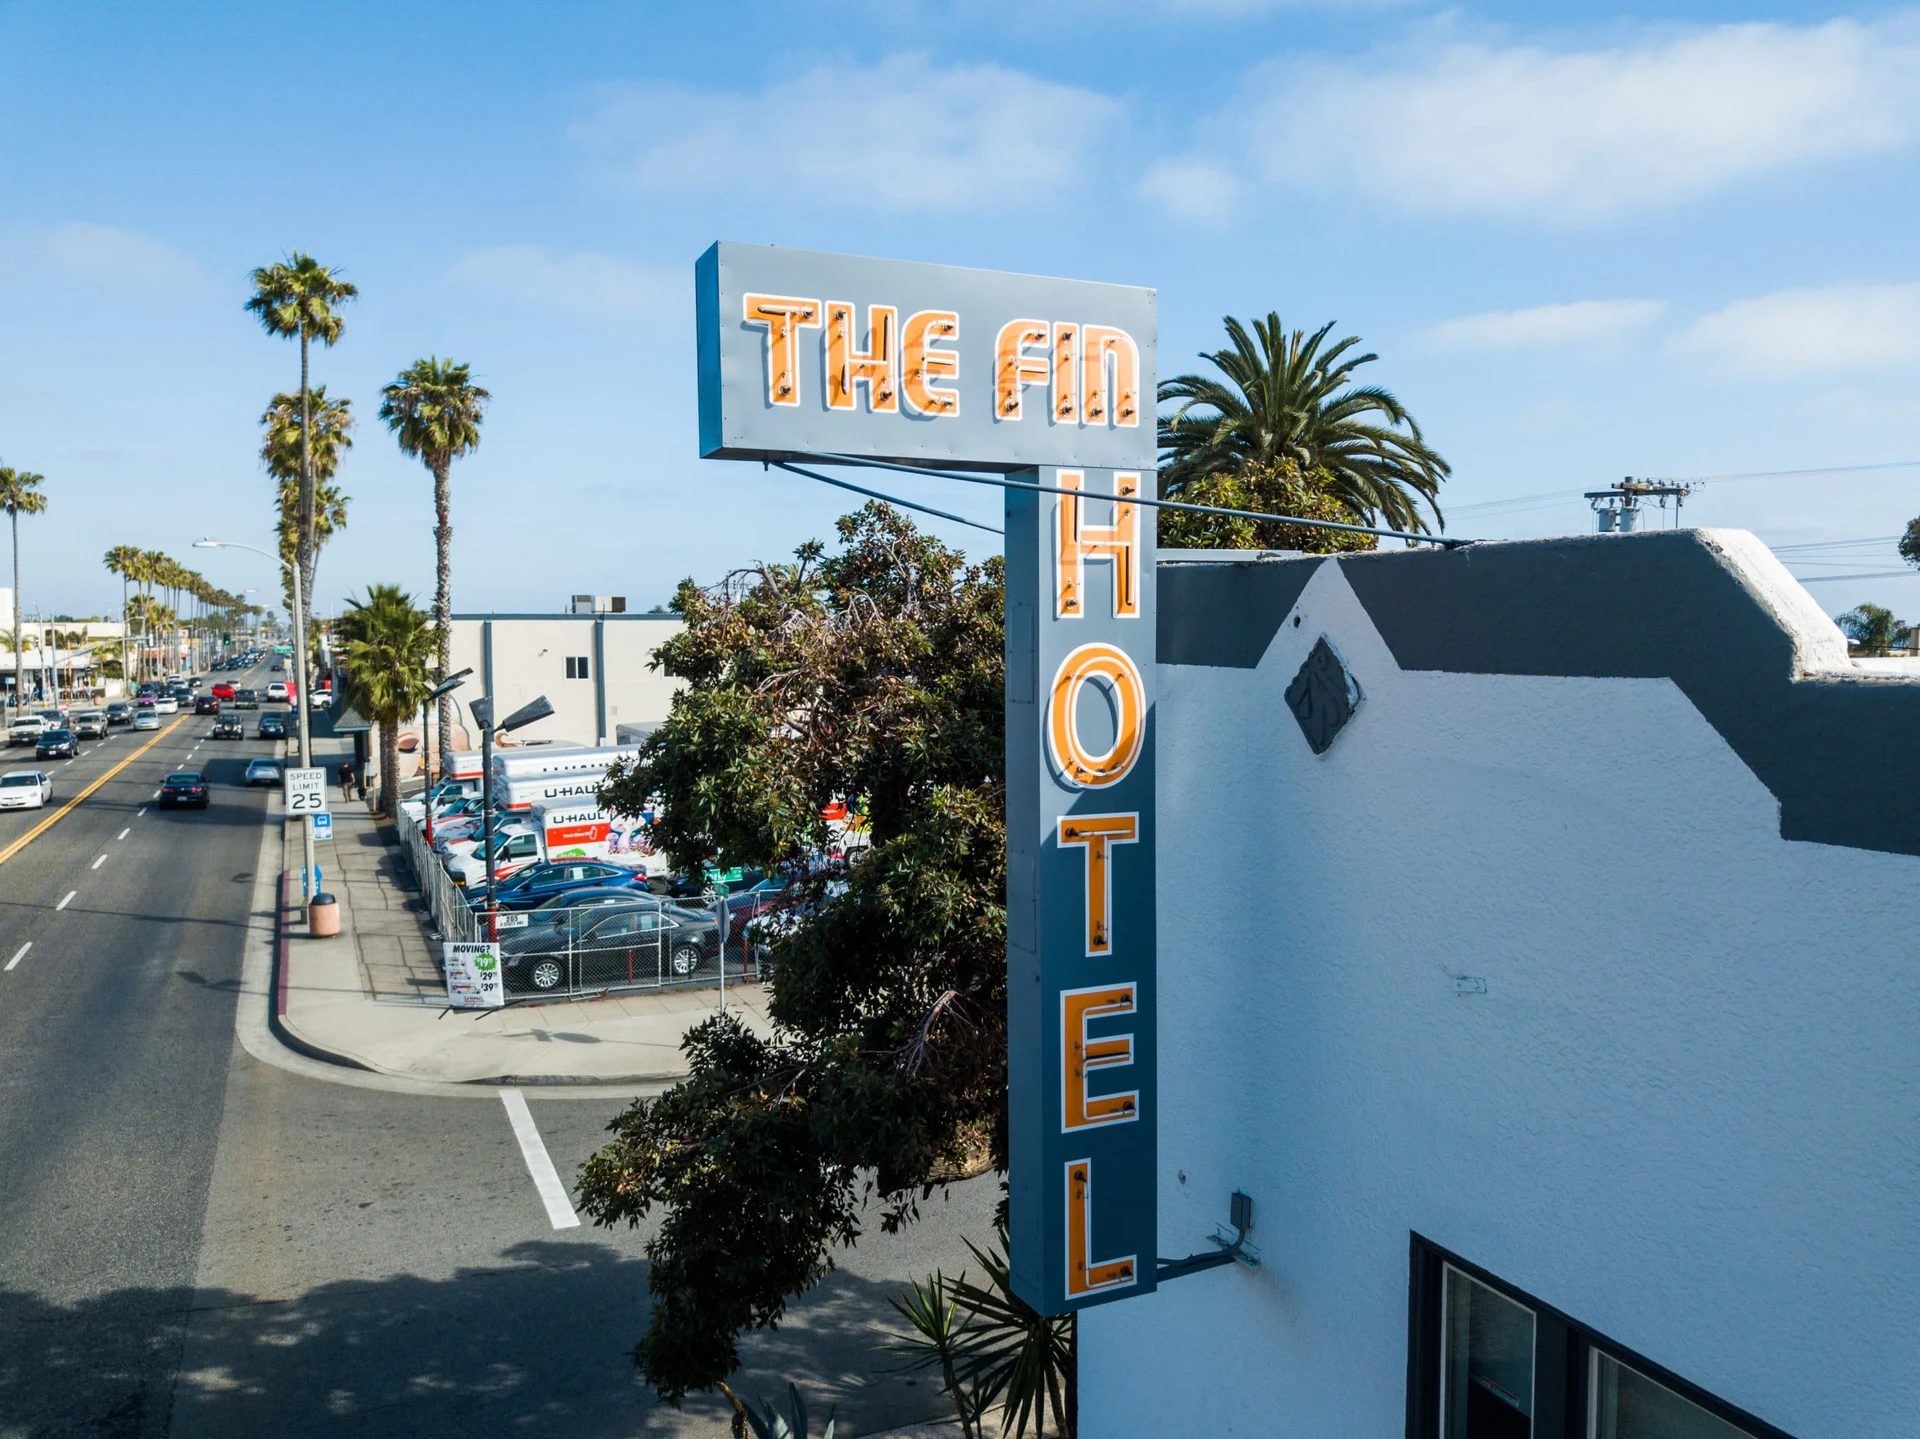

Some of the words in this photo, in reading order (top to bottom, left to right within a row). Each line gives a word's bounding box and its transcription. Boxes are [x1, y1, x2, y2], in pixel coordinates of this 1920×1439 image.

[743, 292, 960, 418] THE
[994, 318, 1141, 429] FIN
[290, 772, 323, 781] SPEED
[292, 782, 320, 791] LIMIT
[544, 784, 600, 798] U-HAU
[292, 792, 322, 809] 25
[553, 812, 605, 824] U-HAUL
[1047, 468, 1148, 1300] HOTEL
[452, 945, 491, 953] MOVING?
